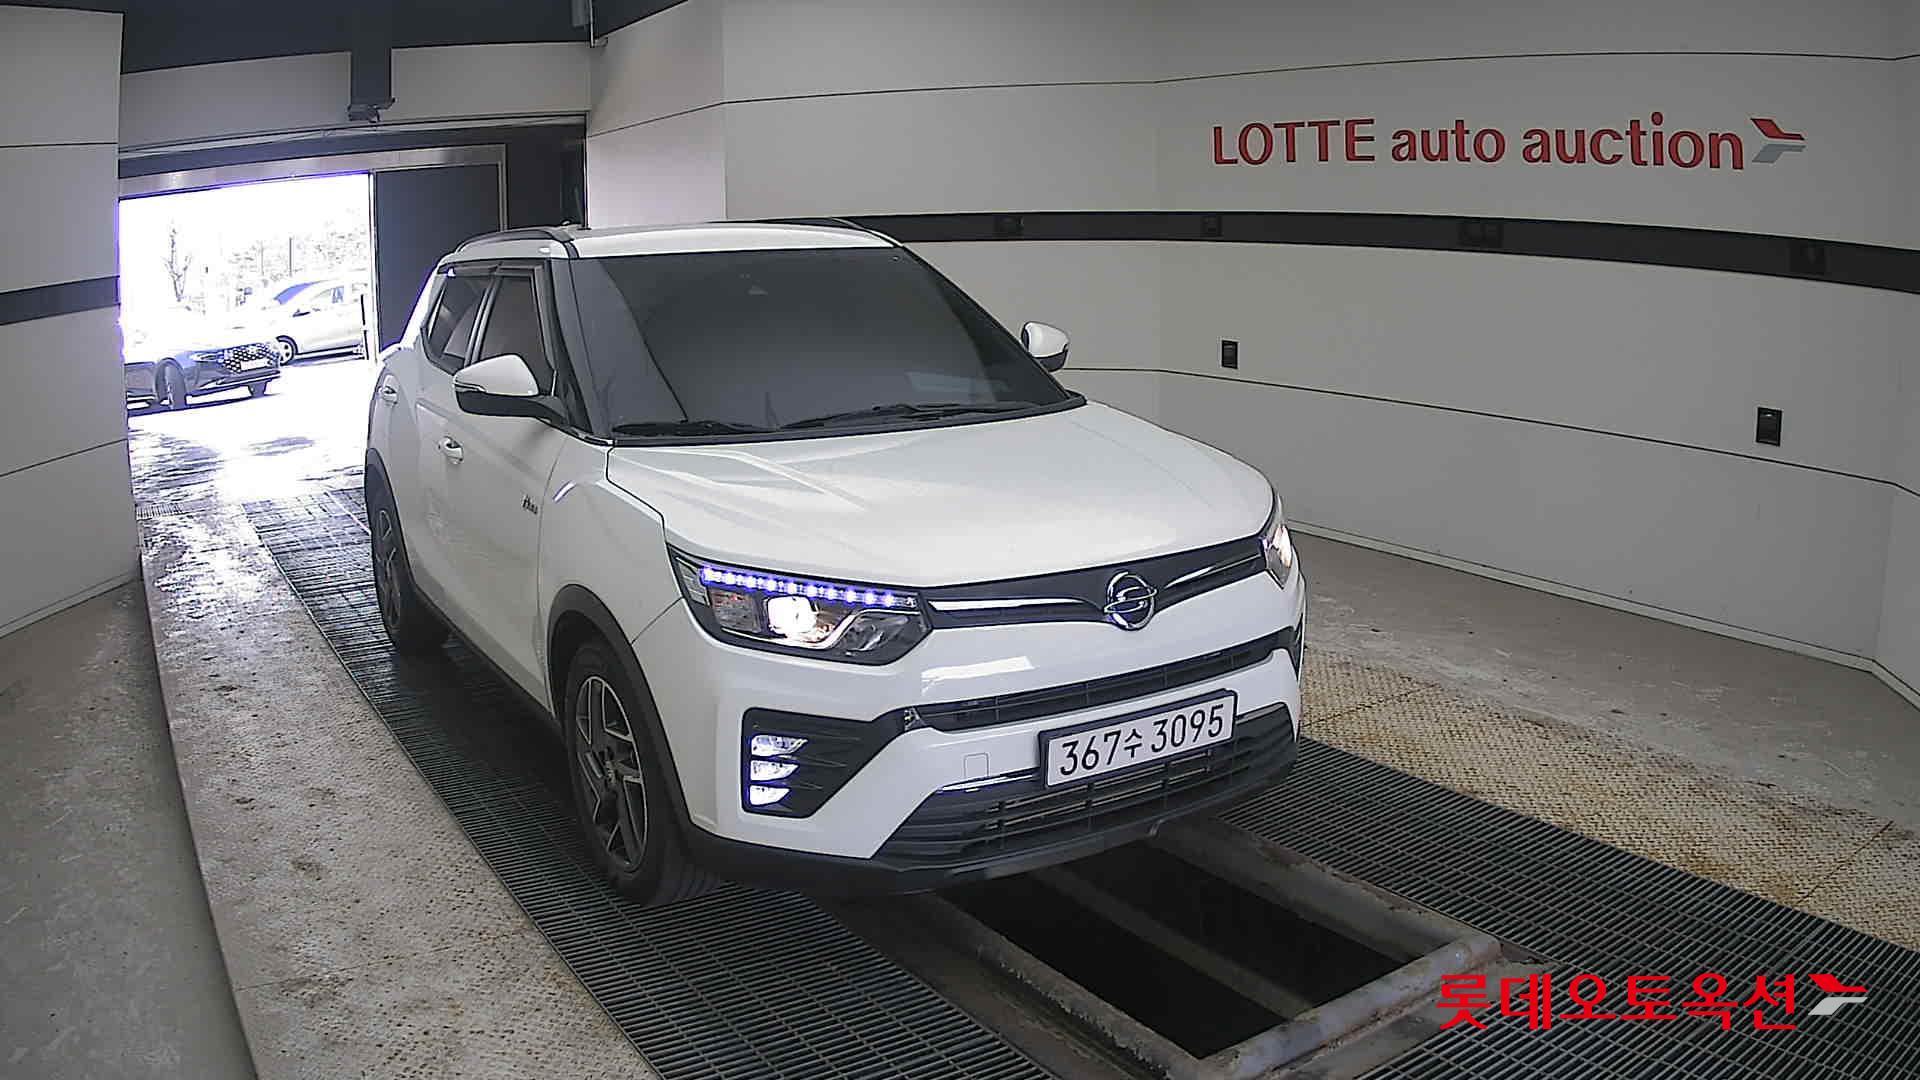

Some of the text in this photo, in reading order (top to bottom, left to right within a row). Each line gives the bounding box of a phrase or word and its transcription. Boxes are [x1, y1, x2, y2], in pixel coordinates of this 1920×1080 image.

[1213, 112, 1744, 170] LOTTE auto auction
